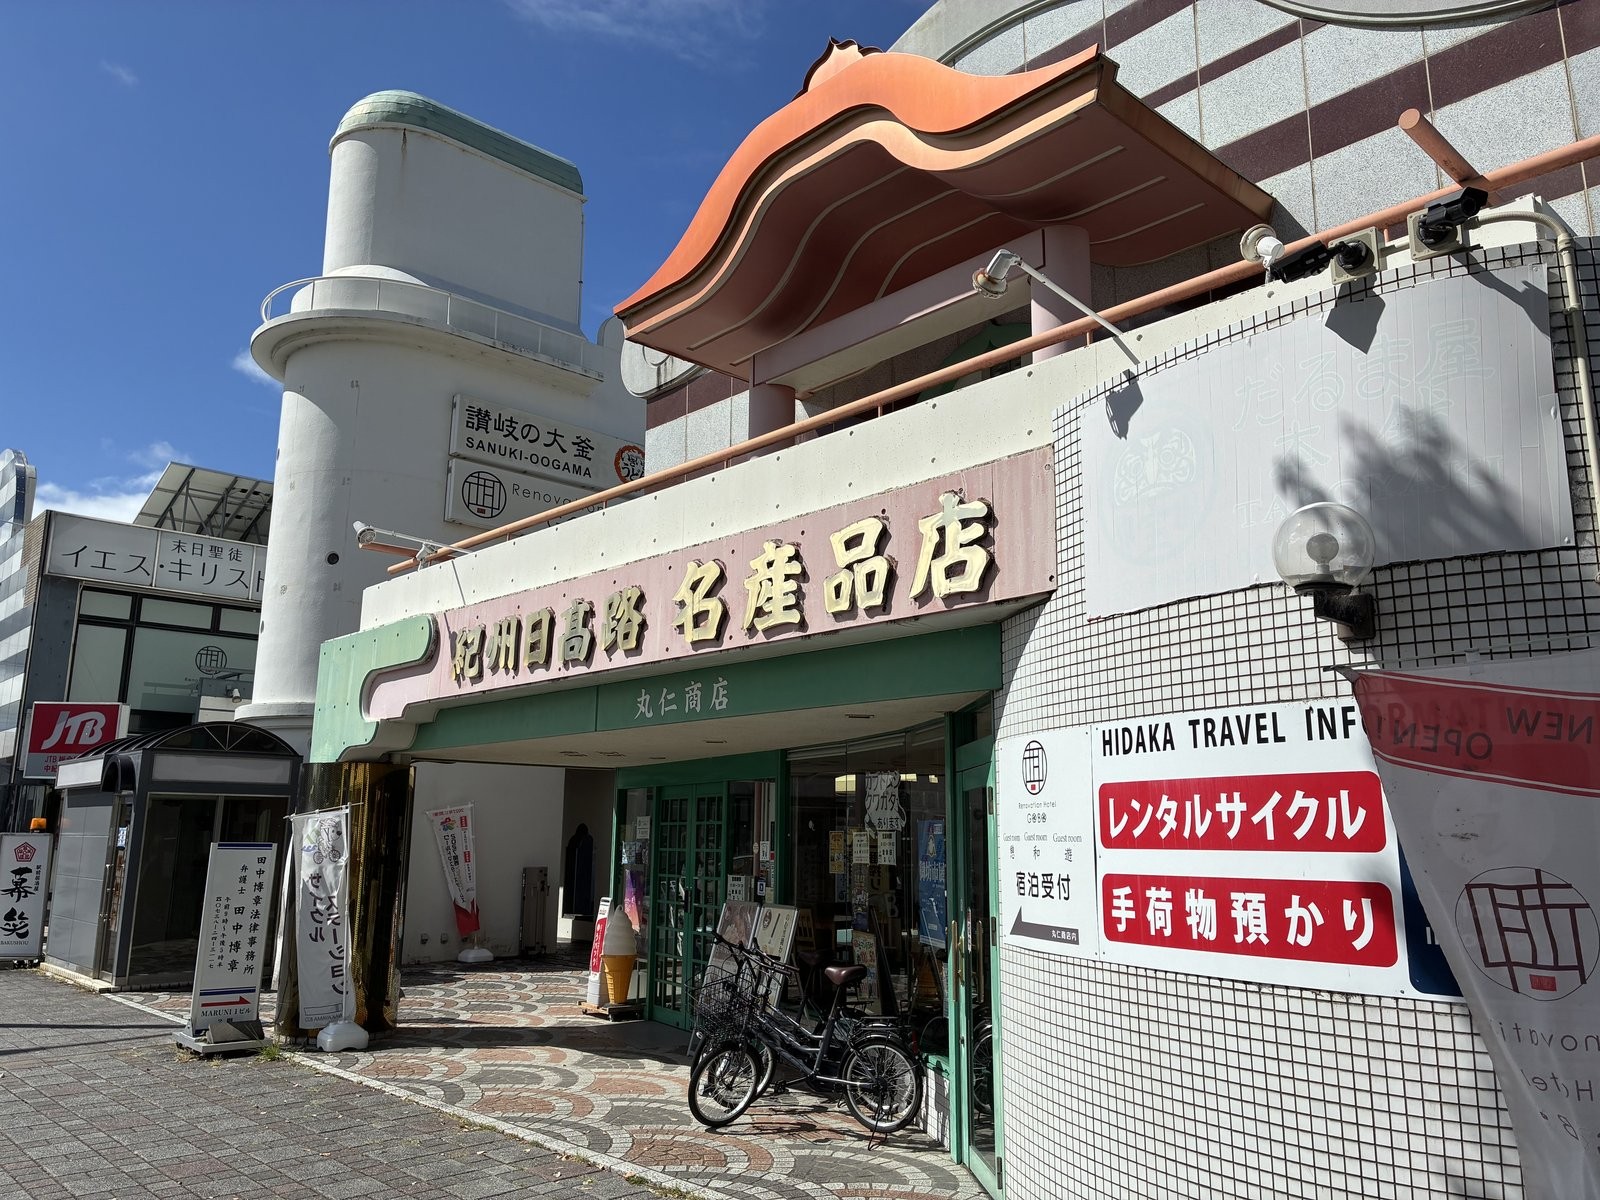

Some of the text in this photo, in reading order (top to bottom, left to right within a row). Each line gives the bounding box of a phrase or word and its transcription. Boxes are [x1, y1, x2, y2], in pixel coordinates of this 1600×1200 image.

[465, 406, 595, 462] 讃岐の大釜
[466, 437, 593, 478] SANUKI-OOGAMA
[172, 539, 243, 563] 末日聖徒
[672, 491, 993, 645] 名産品店
[634, 676, 730, 720] 丸仁商店
[41, 711, 106, 750] JTB
[1101, 721, 1176, 757] HIDAKA
[1187, 711, 1287, 749] TRAVEL
[1043, 800, 1057, 808] Hotel
[1107, 788, 1368, 842] レンタルサイクル
[1016, 872, 1071, 901] 宿泊受付
[227, 864, 249, 973] 弁護士 田中博章
[243, 856, 267, 975] 田中博章法律事務所
[1111, 885, 1374, 952] 手荷物預かり
[201, 1008, 232, 1017] MARUNI
